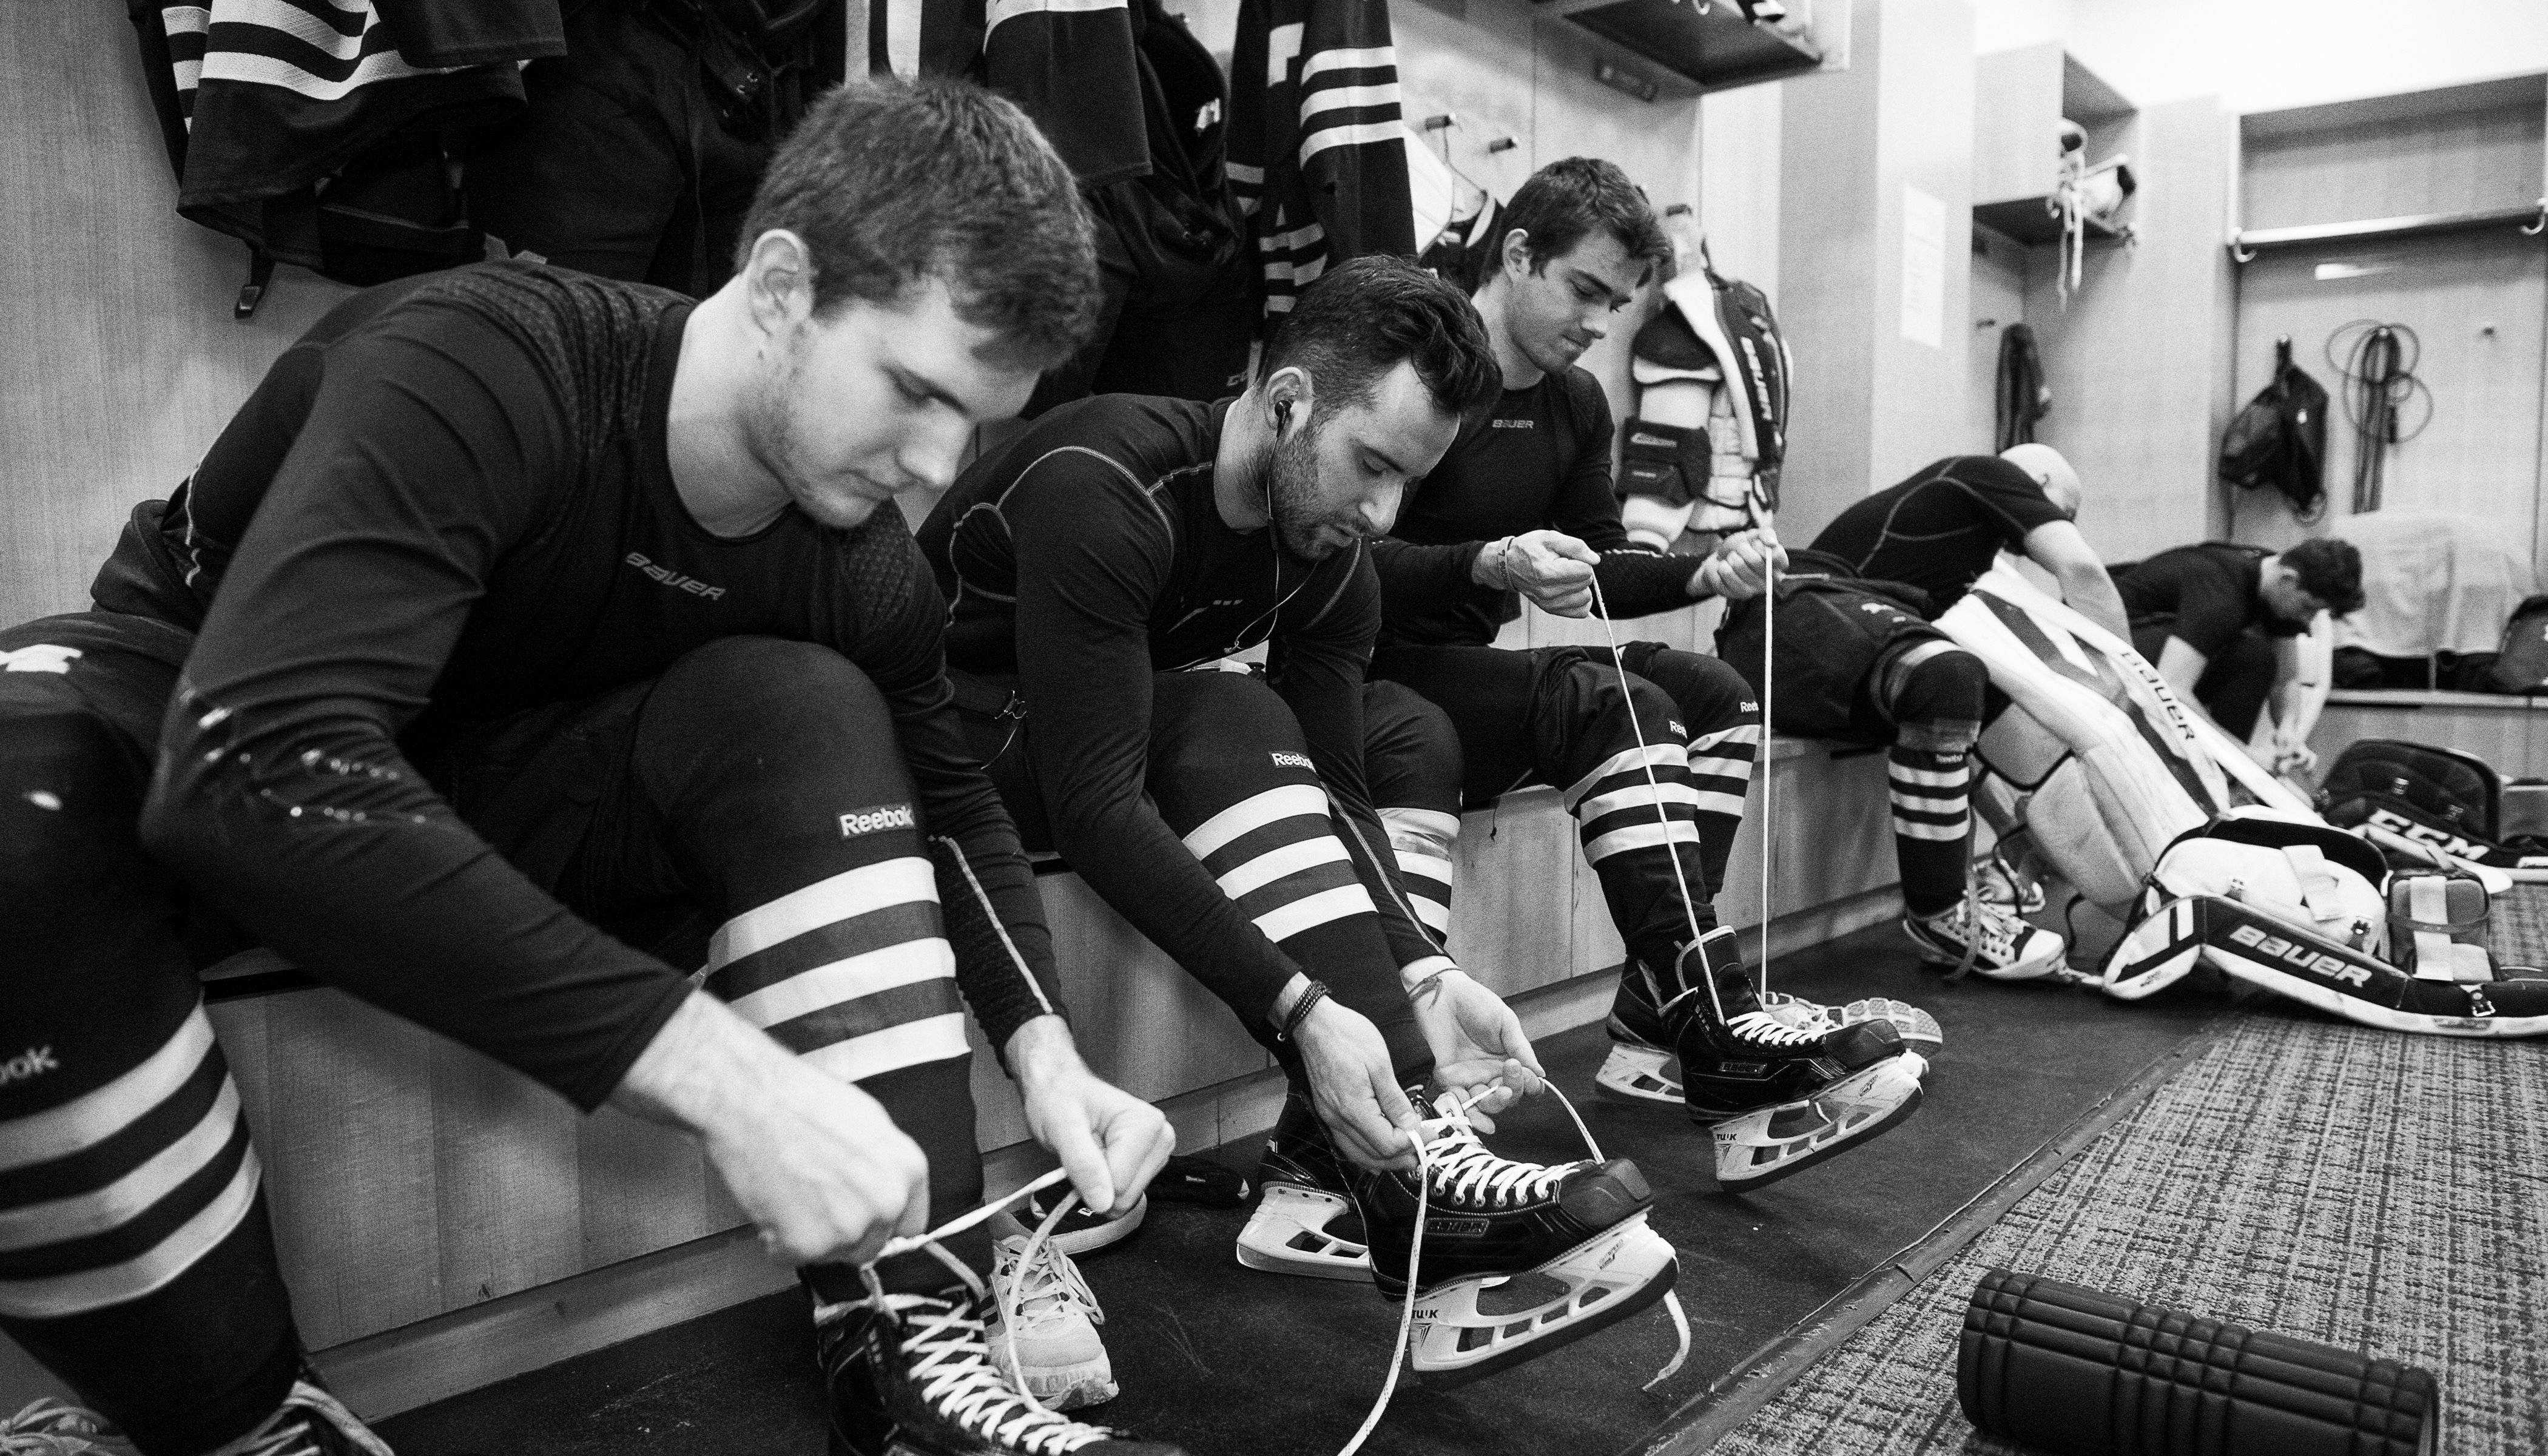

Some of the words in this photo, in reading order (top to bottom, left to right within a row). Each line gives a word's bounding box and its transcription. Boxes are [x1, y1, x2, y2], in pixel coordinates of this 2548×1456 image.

[1492, 419, 1534, 429] BAUER
[626, 551, 727, 601] BAUER
[1740, 701, 1759, 713] Reeb
[840, 805, 915, 837] Reebok
[2368, 807, 2490, 861] CCM
[2229, 924, 2373, 988] BAUER
